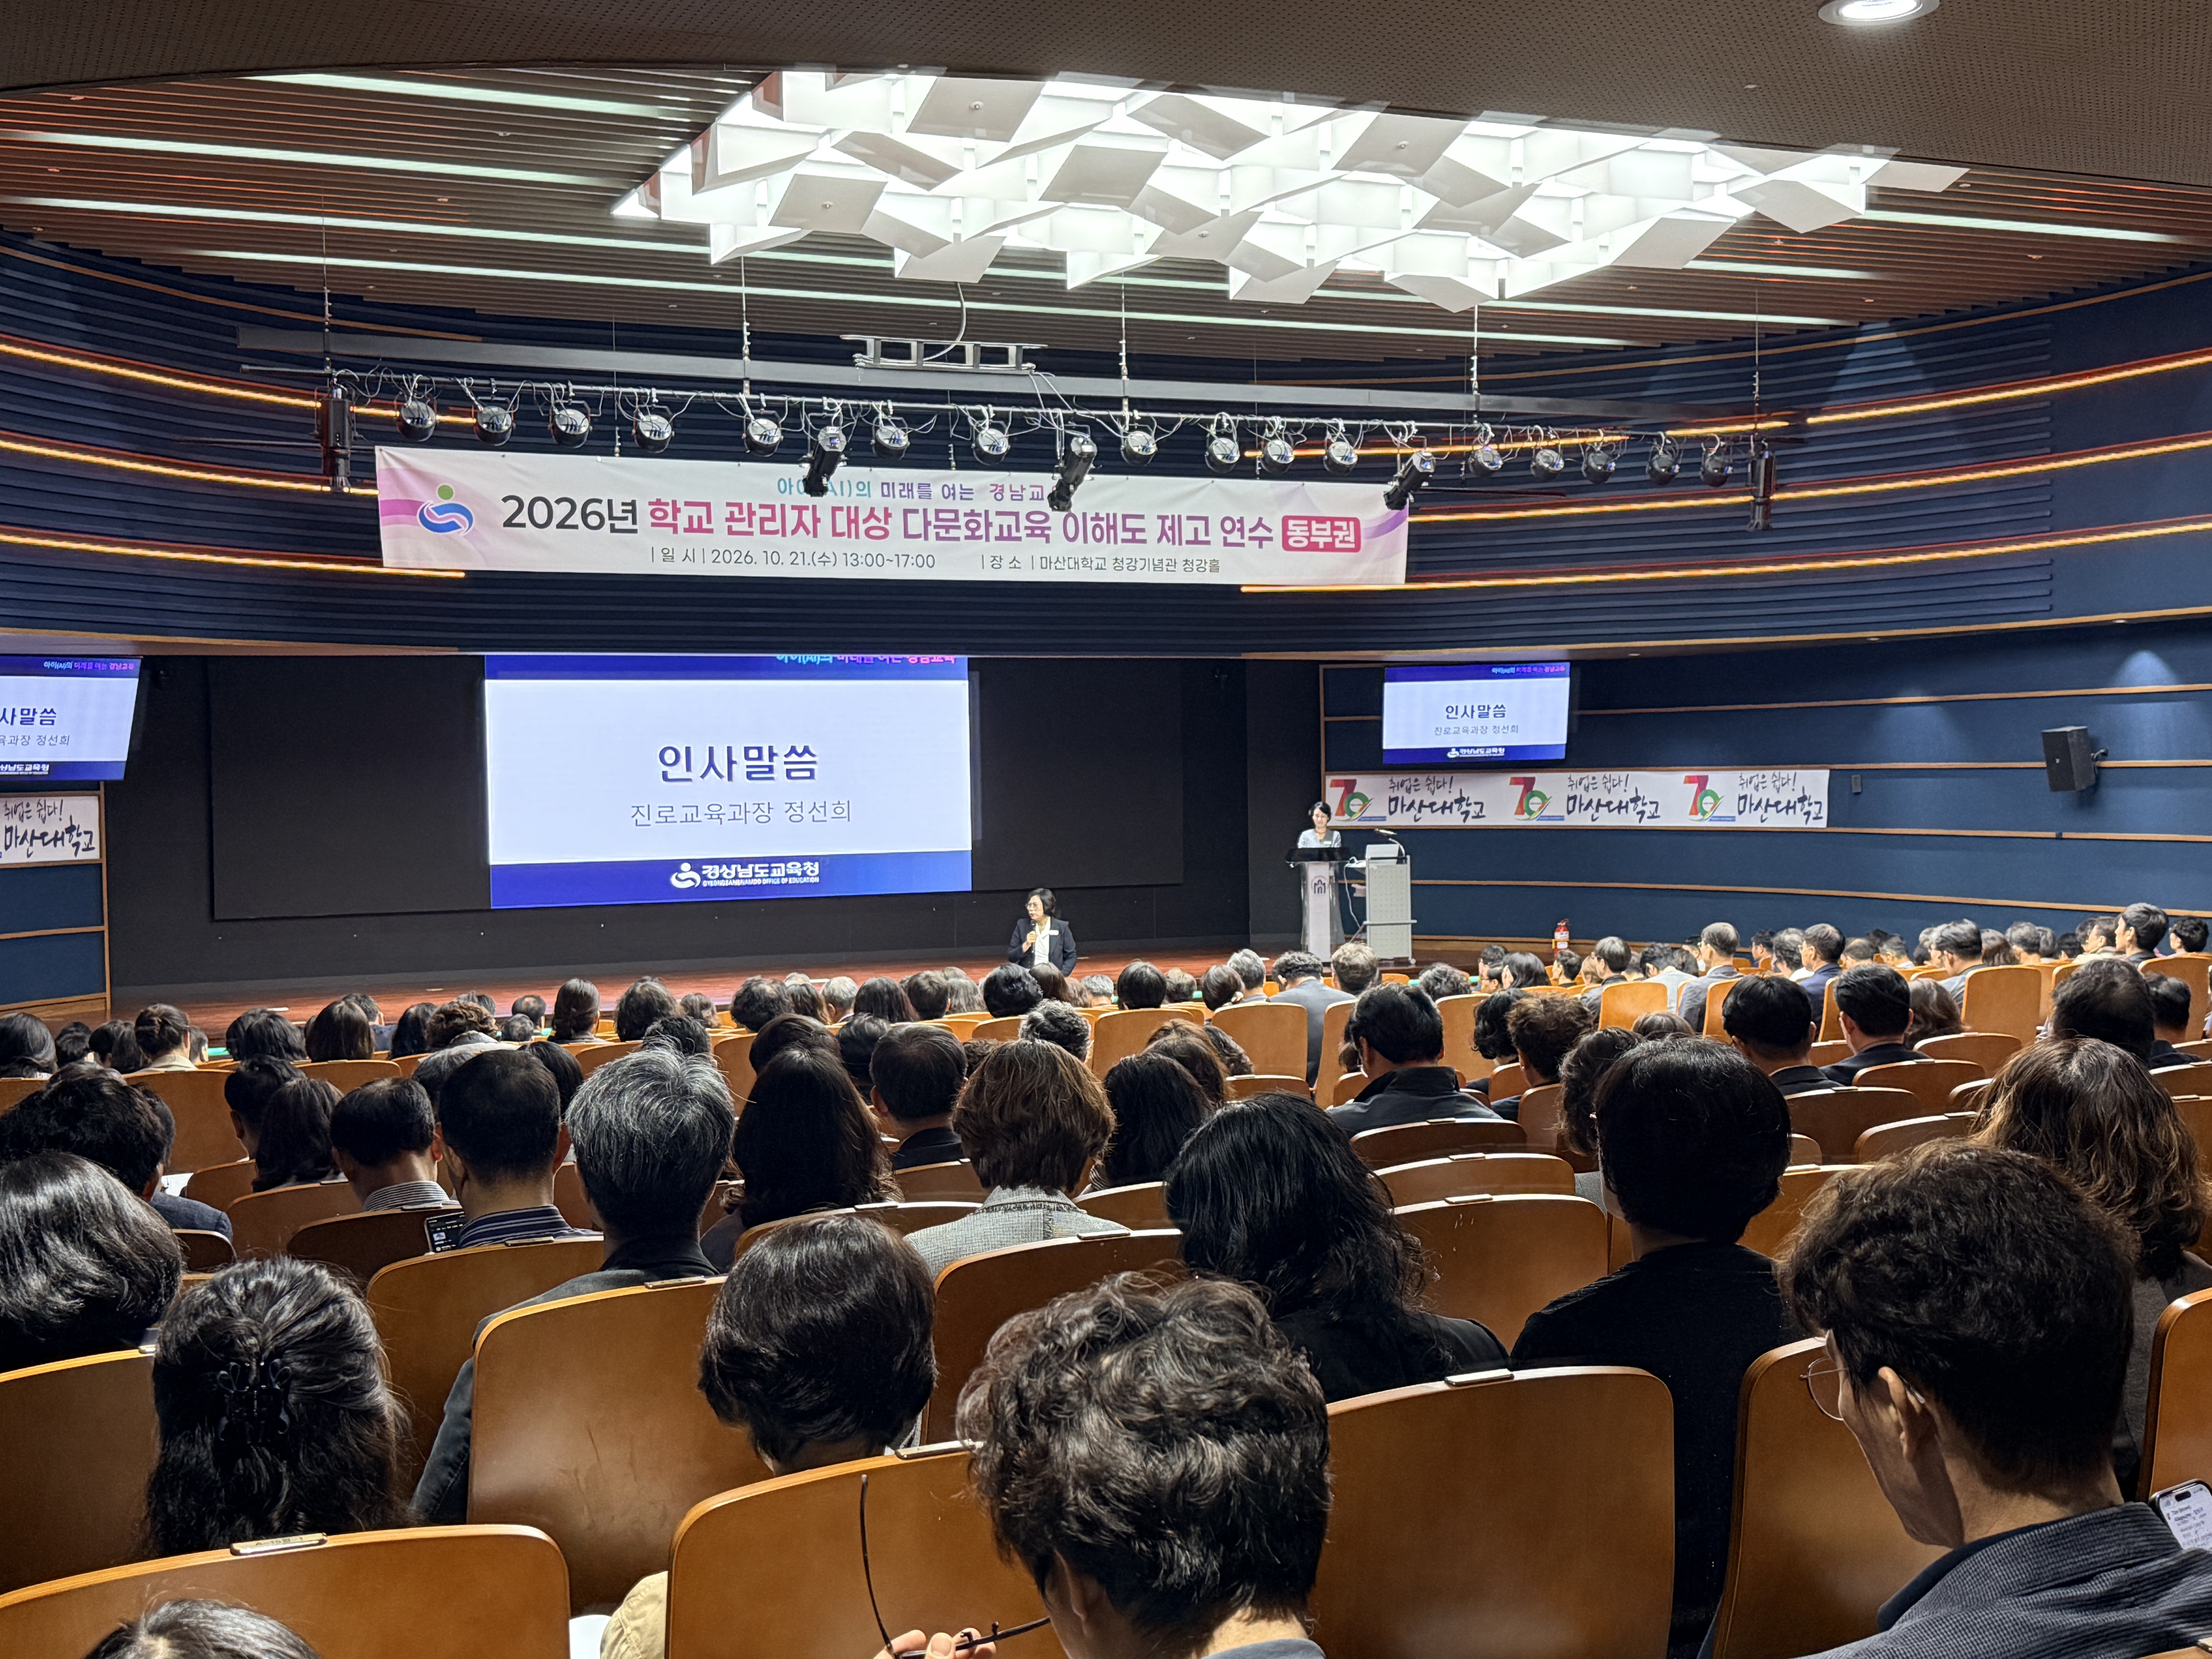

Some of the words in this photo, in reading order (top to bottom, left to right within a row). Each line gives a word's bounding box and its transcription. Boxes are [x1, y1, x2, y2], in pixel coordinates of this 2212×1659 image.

[777, 477, 871, 498] 아AI)의
[881, 481, 933, 500] 미래를
[941, 483, 974, 501] 여는
[989, 483, 1056, 501] 경남교
[501, 495, 638, 534] 2026년
[648, 498, 714, 535] 학교
[725, 501, 821, 539] 관리자
[831, 505, 893, 540] 대상
[903, 507, 1052, 544] 다문화교육
[1063, 511, 1148, 545] 이해도
[1156, 514, 1211, 546] 제고
[1220, 515, 1274, 550] 연수
[1286, 519, 1356, 549] 동부권
[711, 550, 757, 565] 2026.
[763, 550, 784, 566] 10.
[790, 551, 838, 567] 21.(수)
[843, 553, 936, 568] 13:00~17:00
[1040, 557, 1107, 571] 마산대학교
[1112, 558, 1178, 572] 청강기념관
[1182, 559, 1221, 573] 청강홀
[1445, 704, 1506, 720] 인사말씀
[37, 734, 70, 746] 정선희
[1434, 725, 1488, 736] 진로교육과장
[1492, 724, 1519, 734] 정선희
[658, 744, 819, 783] 인사말씀
[1389, 776, 1420, 794] 취업은
[1426, 775, 1454, 796] 쉽다!
[1567, 773, 1599, 793] 취업은
[1602, 773, 1630, 794] 쉽다!
[1738, 773, 1768, 792] 취업은
[1771, 772, 1797, 794] 쉽다!
[4, 802, 33, 823] 취업은
[37, 799, 63, 824] 쉽다!
[630, 802, 775, 828] 진로교육과장
[784, 799, 852, 825] 정선희
[1388, 788, 1486, 823] 마산대학교
[1566, 787, 1661, 823] 마산대학교
[1737, 786, 1824, 825] 마산대학교
[4, 814, 96, 858] 마산대학교
[702, 862, 819, 879] 경상남도교육청
